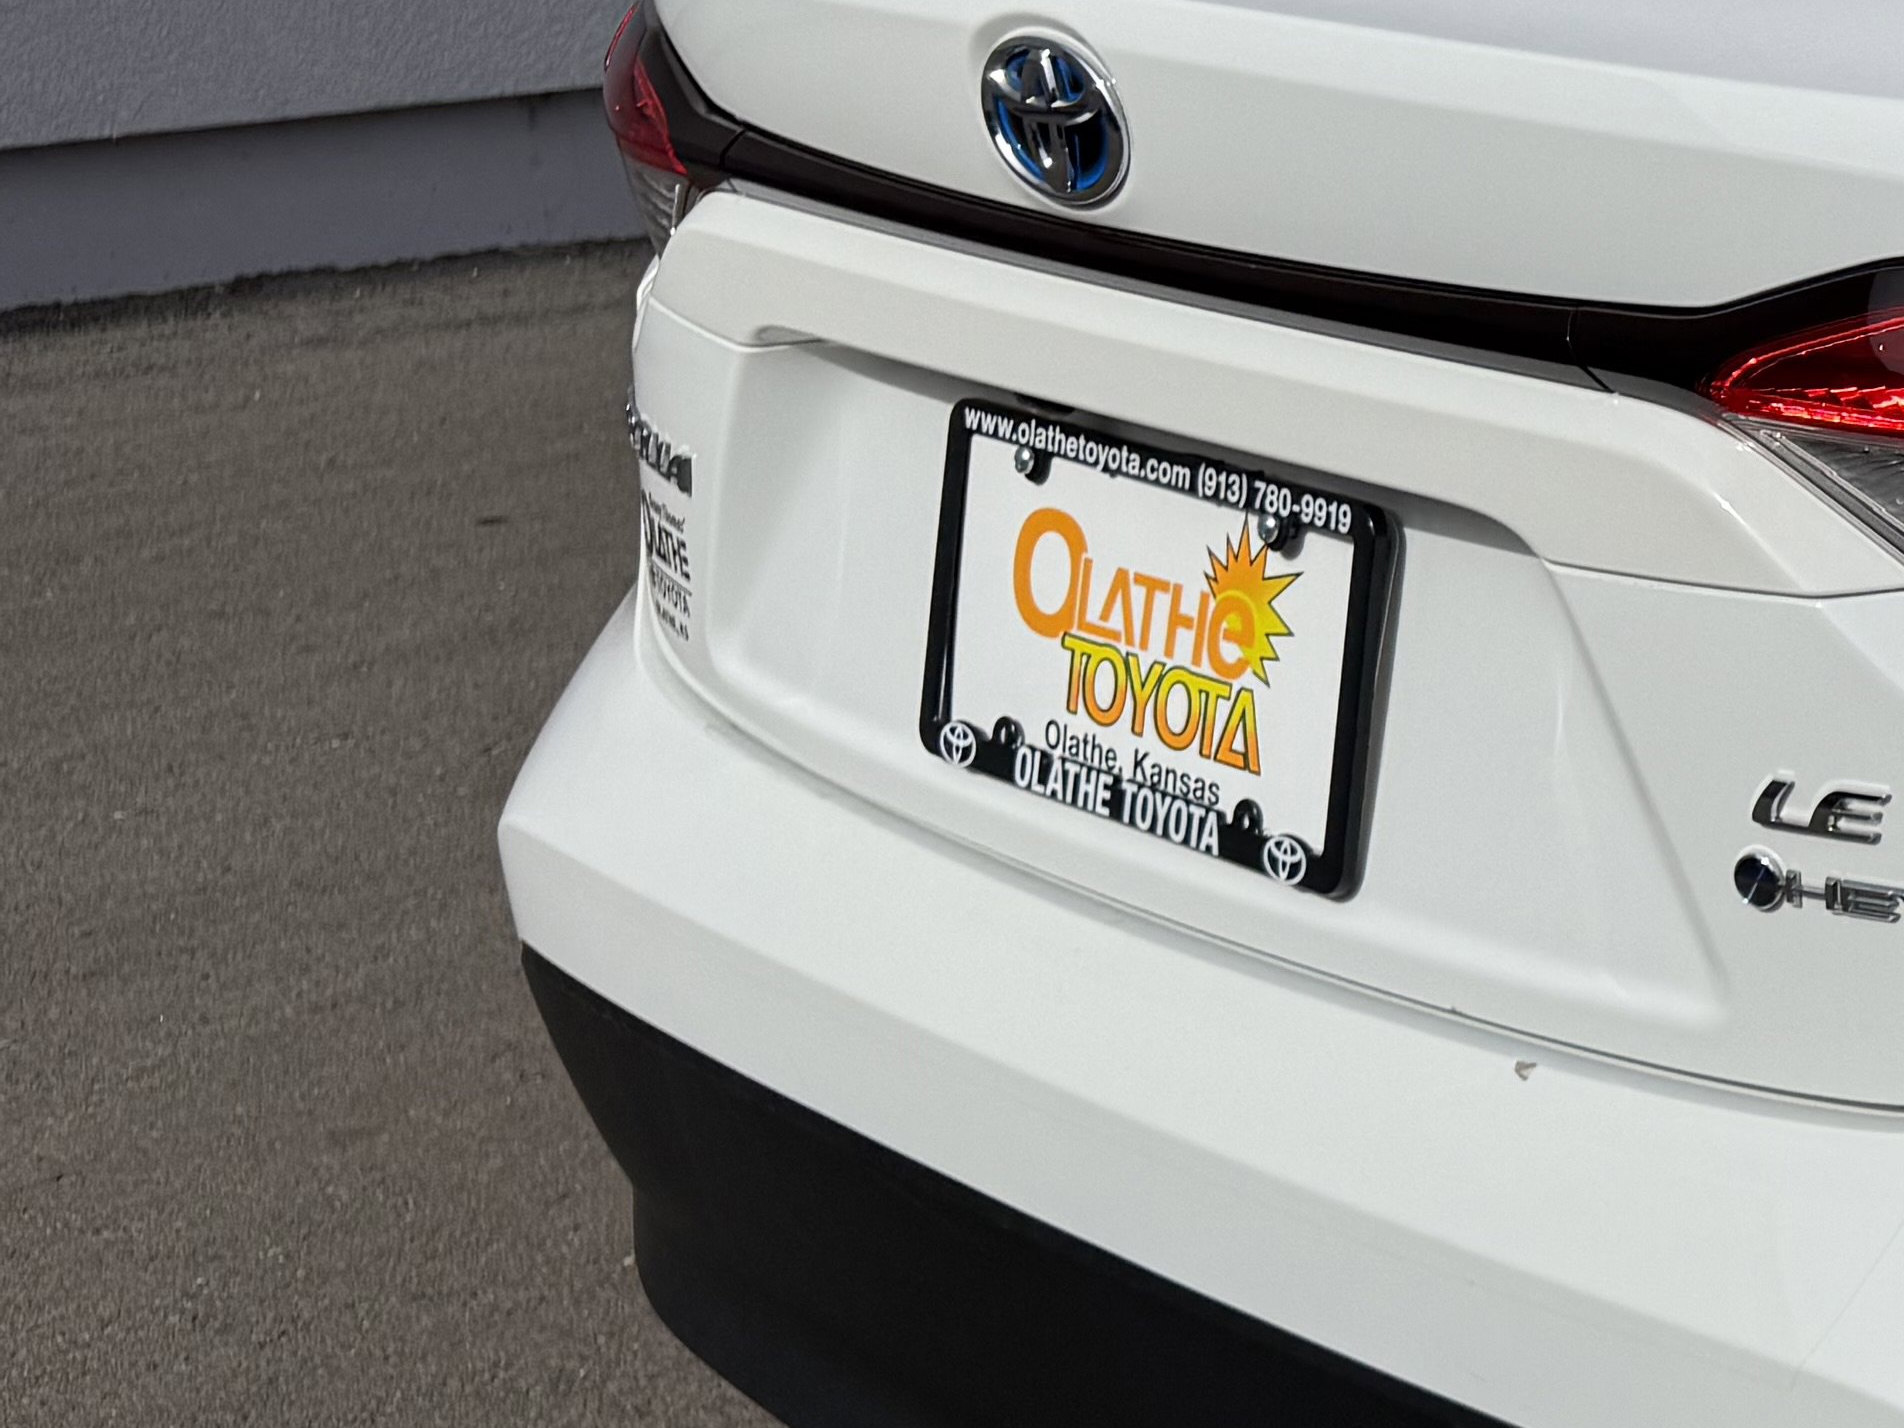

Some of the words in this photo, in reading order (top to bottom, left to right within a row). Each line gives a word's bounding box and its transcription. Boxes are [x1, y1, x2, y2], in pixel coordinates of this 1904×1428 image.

[964, 406, 1191, 491] www.olathetoyota.com
[1197, 467, 1248, 509] (913)
[1253, 479, 1352, 534] 780-9919
[1061, 631, 1262, 777] TOYOTA
[1014, 745, 1112, 817] OLATHE
[1120, 780, 1220, 857] TOYOTA
[1133, 746, 1220, 807] Kansas
[1751, 773, 1893, 846] LE
